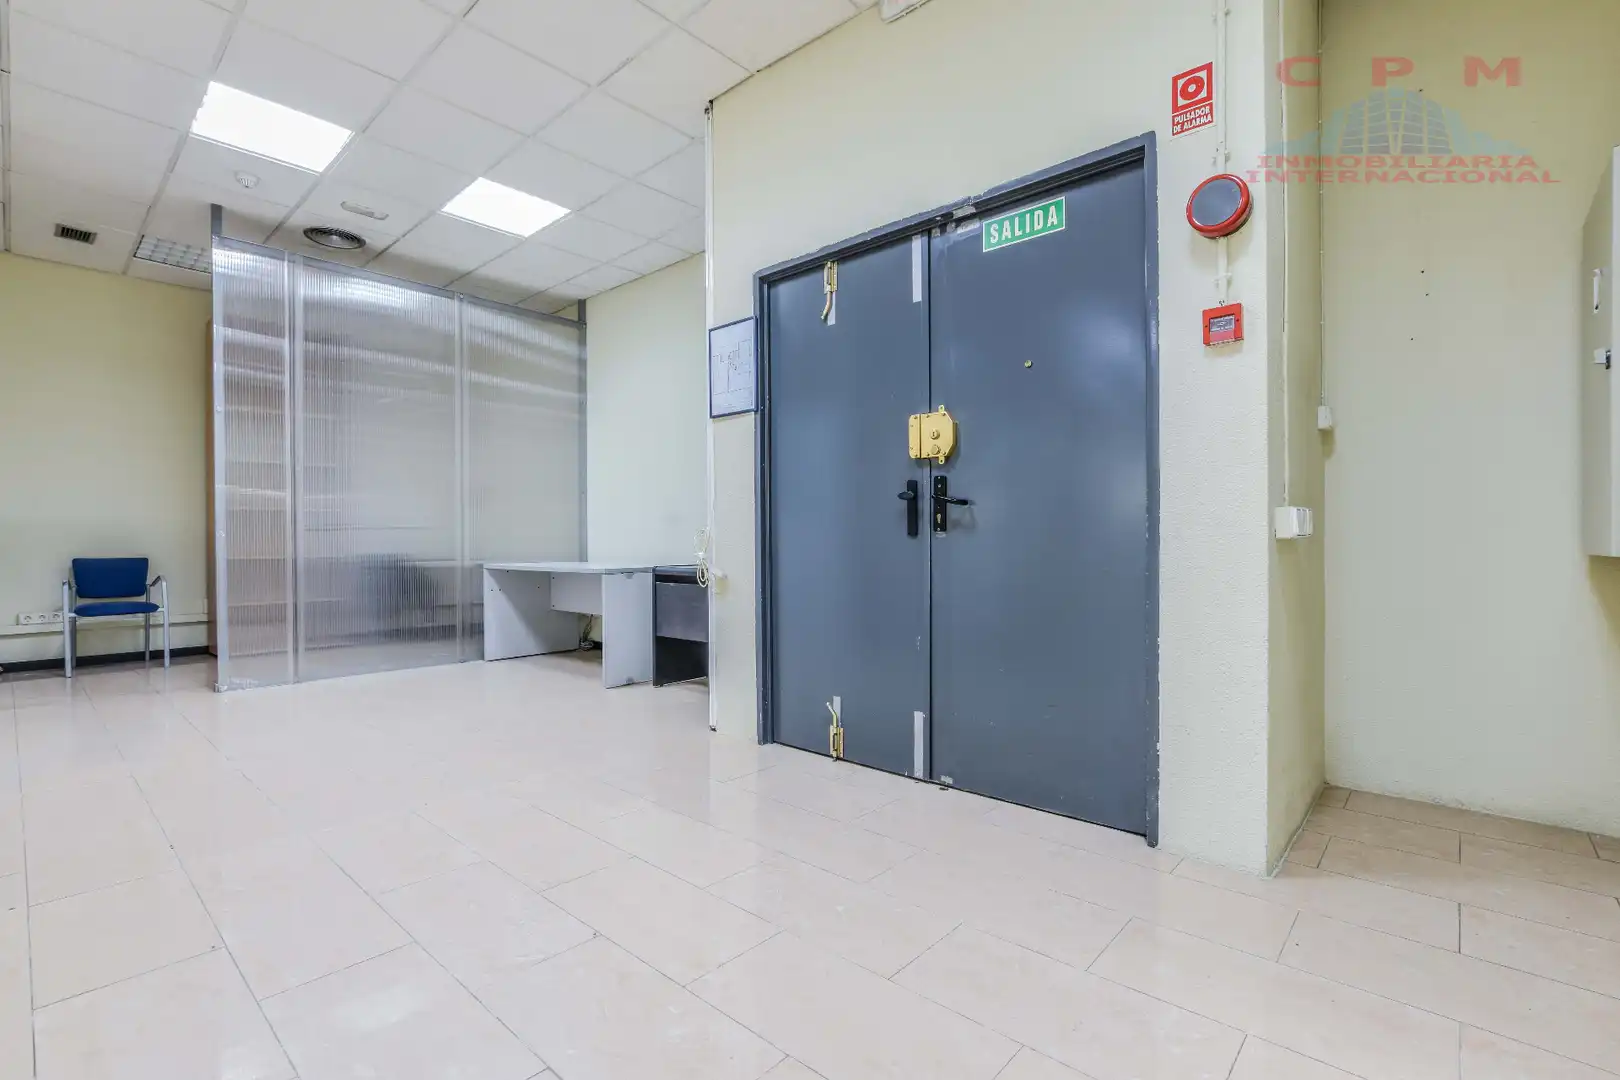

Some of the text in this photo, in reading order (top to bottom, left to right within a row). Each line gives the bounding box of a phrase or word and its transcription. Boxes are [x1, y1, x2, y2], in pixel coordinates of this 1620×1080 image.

[1173, 114, 1212, 134] DE ALARMA
[1174, 106, 1210, 124] PULSADOR
[990, 205, 1058, 244] SALIDA
